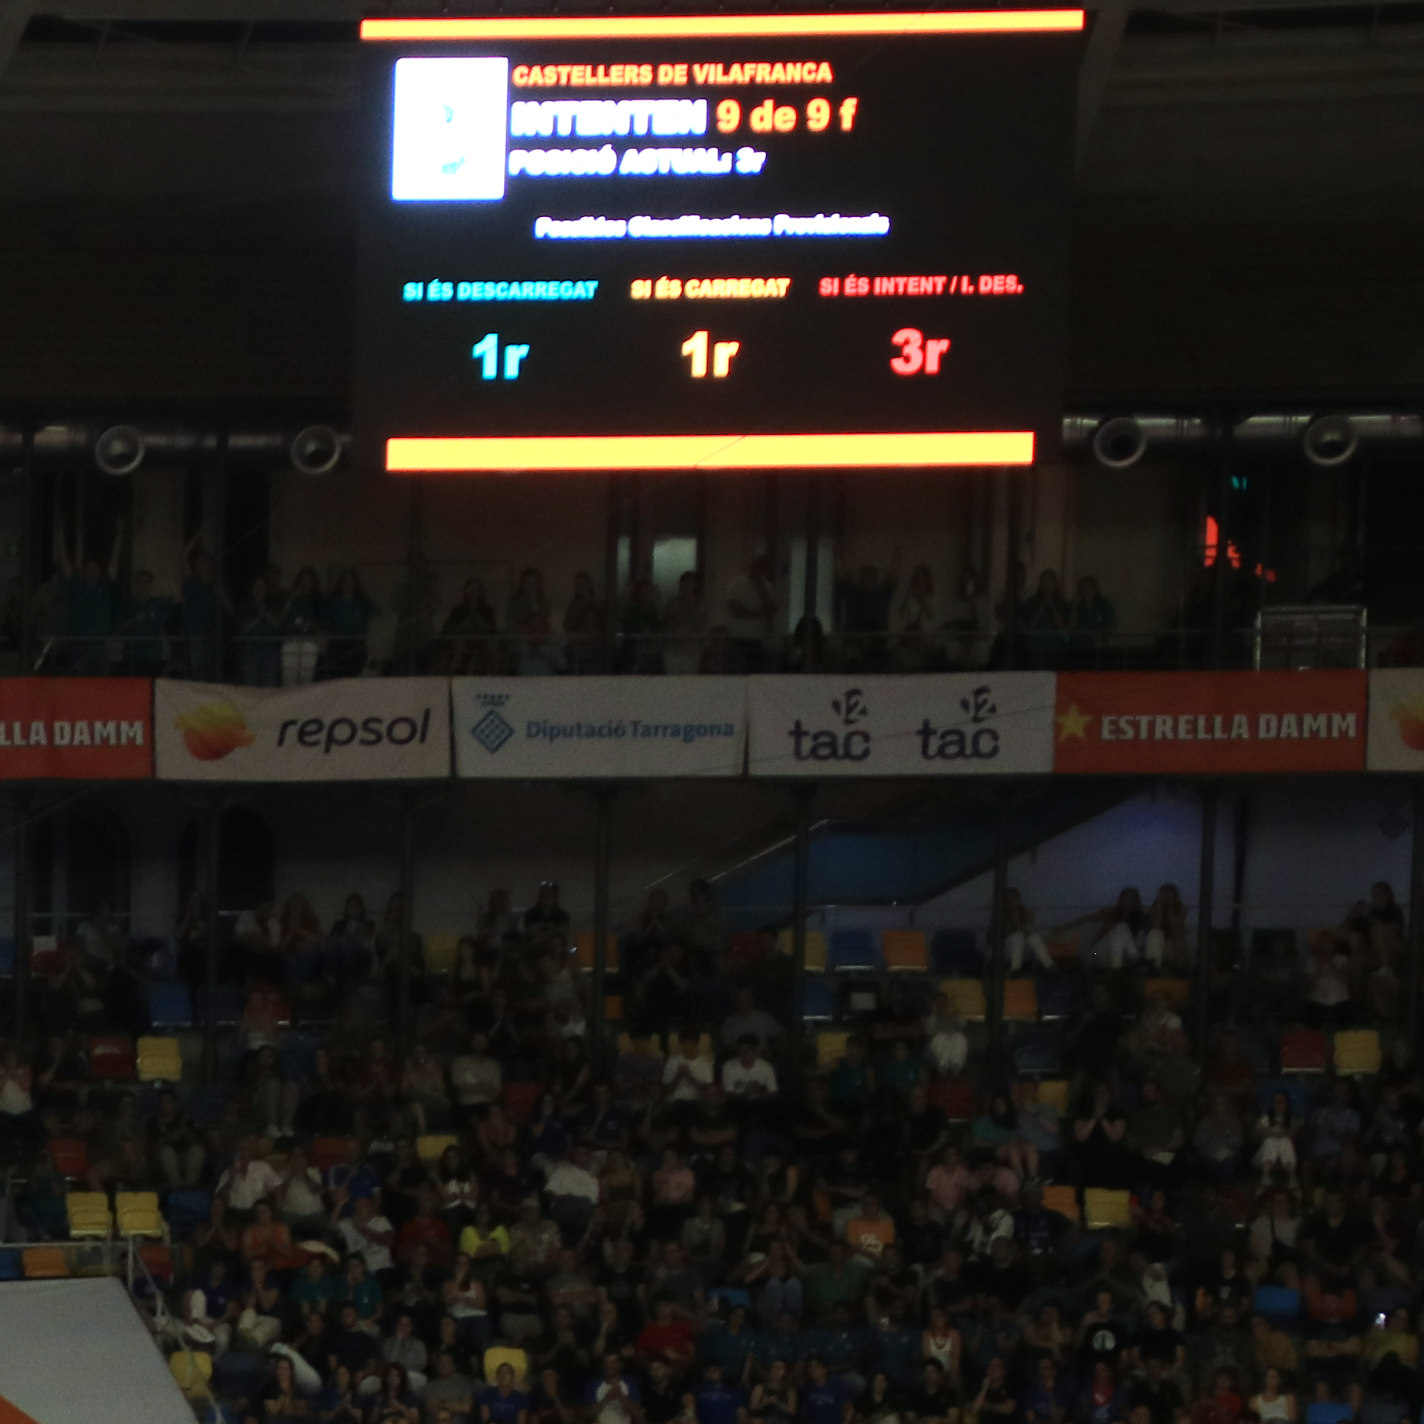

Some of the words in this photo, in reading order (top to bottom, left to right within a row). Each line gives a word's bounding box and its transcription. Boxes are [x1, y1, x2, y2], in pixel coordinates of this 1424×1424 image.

[512, 64, 653, 87] CASTELLERS
[657, 64, 689, 85] DE
[692, 61, 833, 84] VILAFRANCA
[510, 99, 708, 137] INTENTEN
[717, 98, 741, 133] 9
[750, 98, 797, 132] de
[806, 97, 832, 132] 9
[839, 96, 858, 132] f
[403, 280, 424, 300] SI
[427, 277, 454, 300] ÉS
[457, 279, 599, 300] DESCARREGAT
[630, 279, 652, 300] SI
[655, 276, 682, 299] ÉS
[684, 277, 791, 299] CARREGAT
[818, 276, 840, 297] SI
[843, 274, 870, 296] ÉS
[873, 275, 947, 296] INTENT
[471, 332, 531, 380] 1r
[681, 329, 740, 378] 1r
[889, 327, 950, 377] 3r
[53, 719, 145, 748] DAMM
[277, 707, 432, 754] repsol
[525, 717, 625, 744] Diputació
[629, 716, 736, 744] Tarragona
[789, 719, 871, 761] tac
[915, 717, 1000, 760] tac
[1100, 713, 1250, 742] ESTRELLA
[1258, 711, 1359, 740] DAMM
